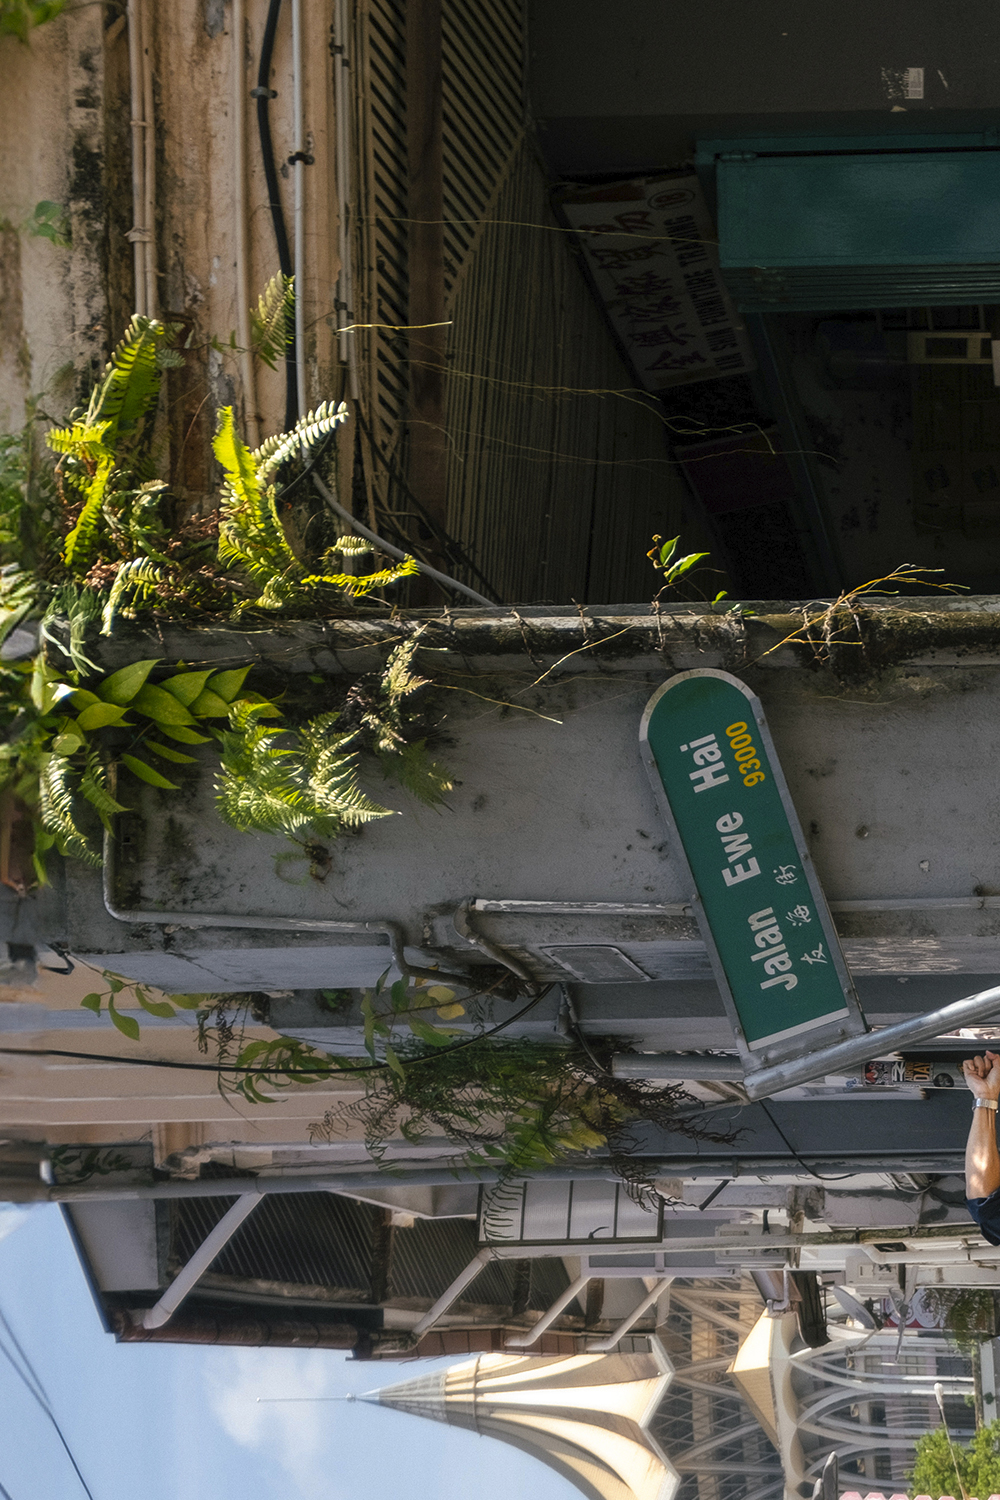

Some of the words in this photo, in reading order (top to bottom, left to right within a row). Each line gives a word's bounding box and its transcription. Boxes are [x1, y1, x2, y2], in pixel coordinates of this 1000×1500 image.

[663, 214, 708, 268] TRADING
[683, 268, 729, 326] FURNITURE
[705, 327, 738, 352] SHIN
[681, 733, 730, 794] Hai
[725, 721, 766, 787] 93000
[715, 811, 762, 887] Ewe
[773, 864, 828, 965] 友海街
[747, 906, 798, 991] Jalan
